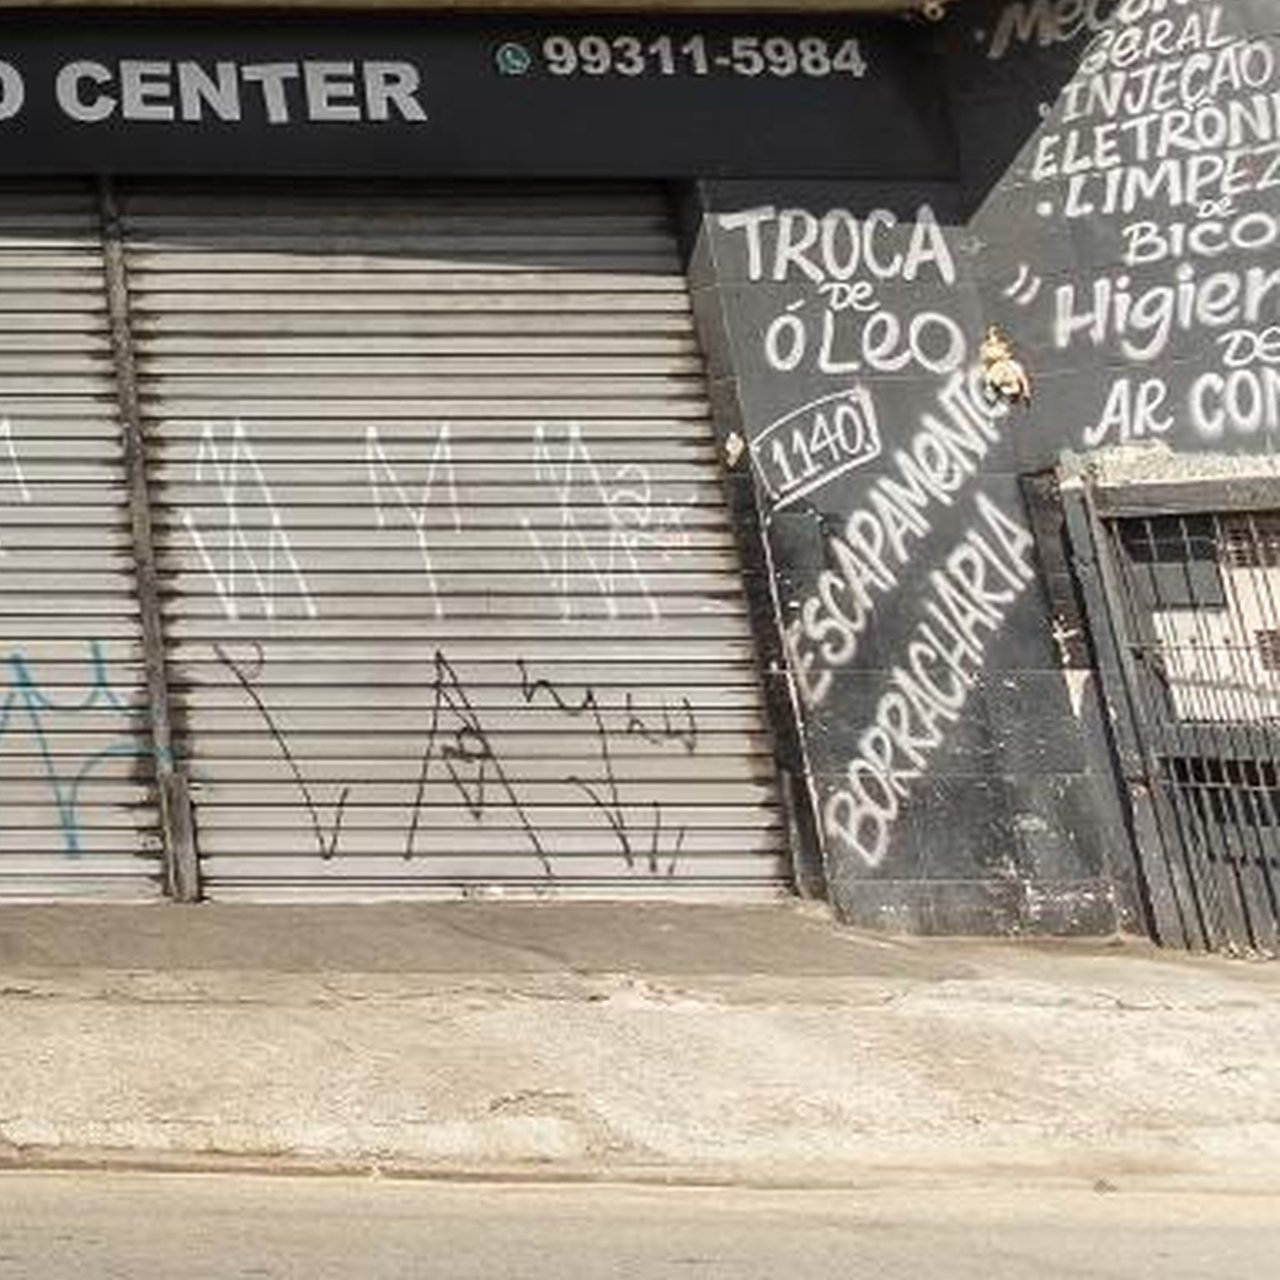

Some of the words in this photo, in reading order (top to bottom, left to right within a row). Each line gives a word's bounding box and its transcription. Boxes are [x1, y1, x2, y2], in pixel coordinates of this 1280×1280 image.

[54, 59, 429, 124] CENTER
[541, 35, 868, 78] 99311-5984
[719, 203, 957, 284] TROCA
[770, 403, 865, 492] 1140
[1082, 377, 1175, 447] AR
[823, 490, 1037, 869] BORRACHARIA
